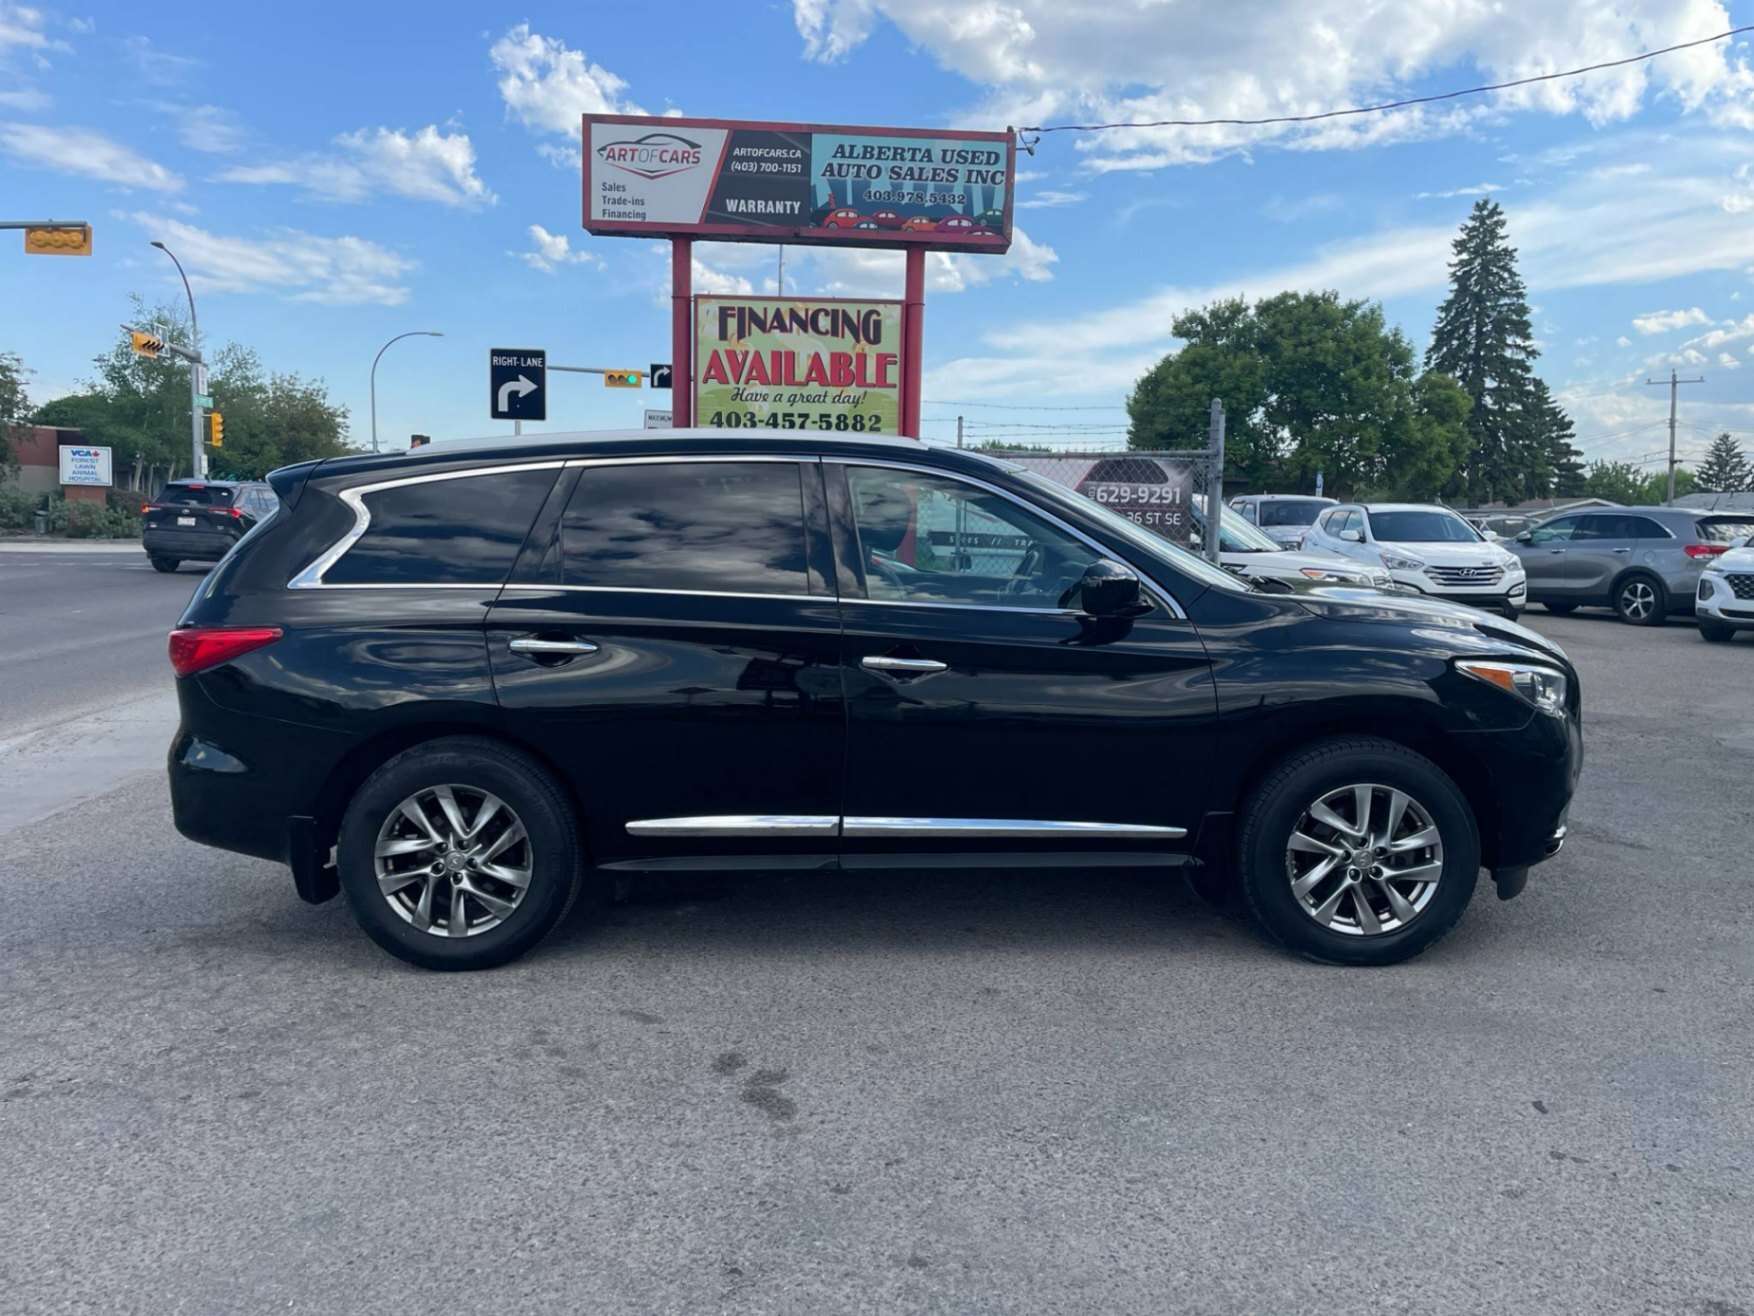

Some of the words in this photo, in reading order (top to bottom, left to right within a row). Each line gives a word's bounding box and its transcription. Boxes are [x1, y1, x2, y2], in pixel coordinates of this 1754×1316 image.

[605, 147, 701, 164] ARTOFCARS
[733, 147, 802, 158] ARTOFCARS.CA
[832, 144, 934, 162] ALBERTA
[941, 149, 1000, 166] USED
[730, 160, 758, 172] (403)
[760, 162, 802, 173] 700-1151
[821, 162, 882, 179] AUTO
[889, 165, 960, 184] SALES
[965, 169, 1005, 186] INC
[601, 182, 626, 193] Sales
[863, 190, 966, 205] 403.978.5432
[601, 208, 647, 221] Financing
[725, 198, 801, 215] WARRANTY
[718, 305, 882, 345] FINANCING
[702, 349, 898, 389] AVAILABLE
[730, 387, 769, 402] Have
[773, 391, 783, 401] a
[787, 391, 828, 407] great
[832, 390, 868, 408] day!
[710, 410, 882, 432] 403-457-5882
[1096, 486, 1181, 504] 629-9291
[1145, 512, 1162, 525] ST
[1164, 513, 1182, 525] SE
